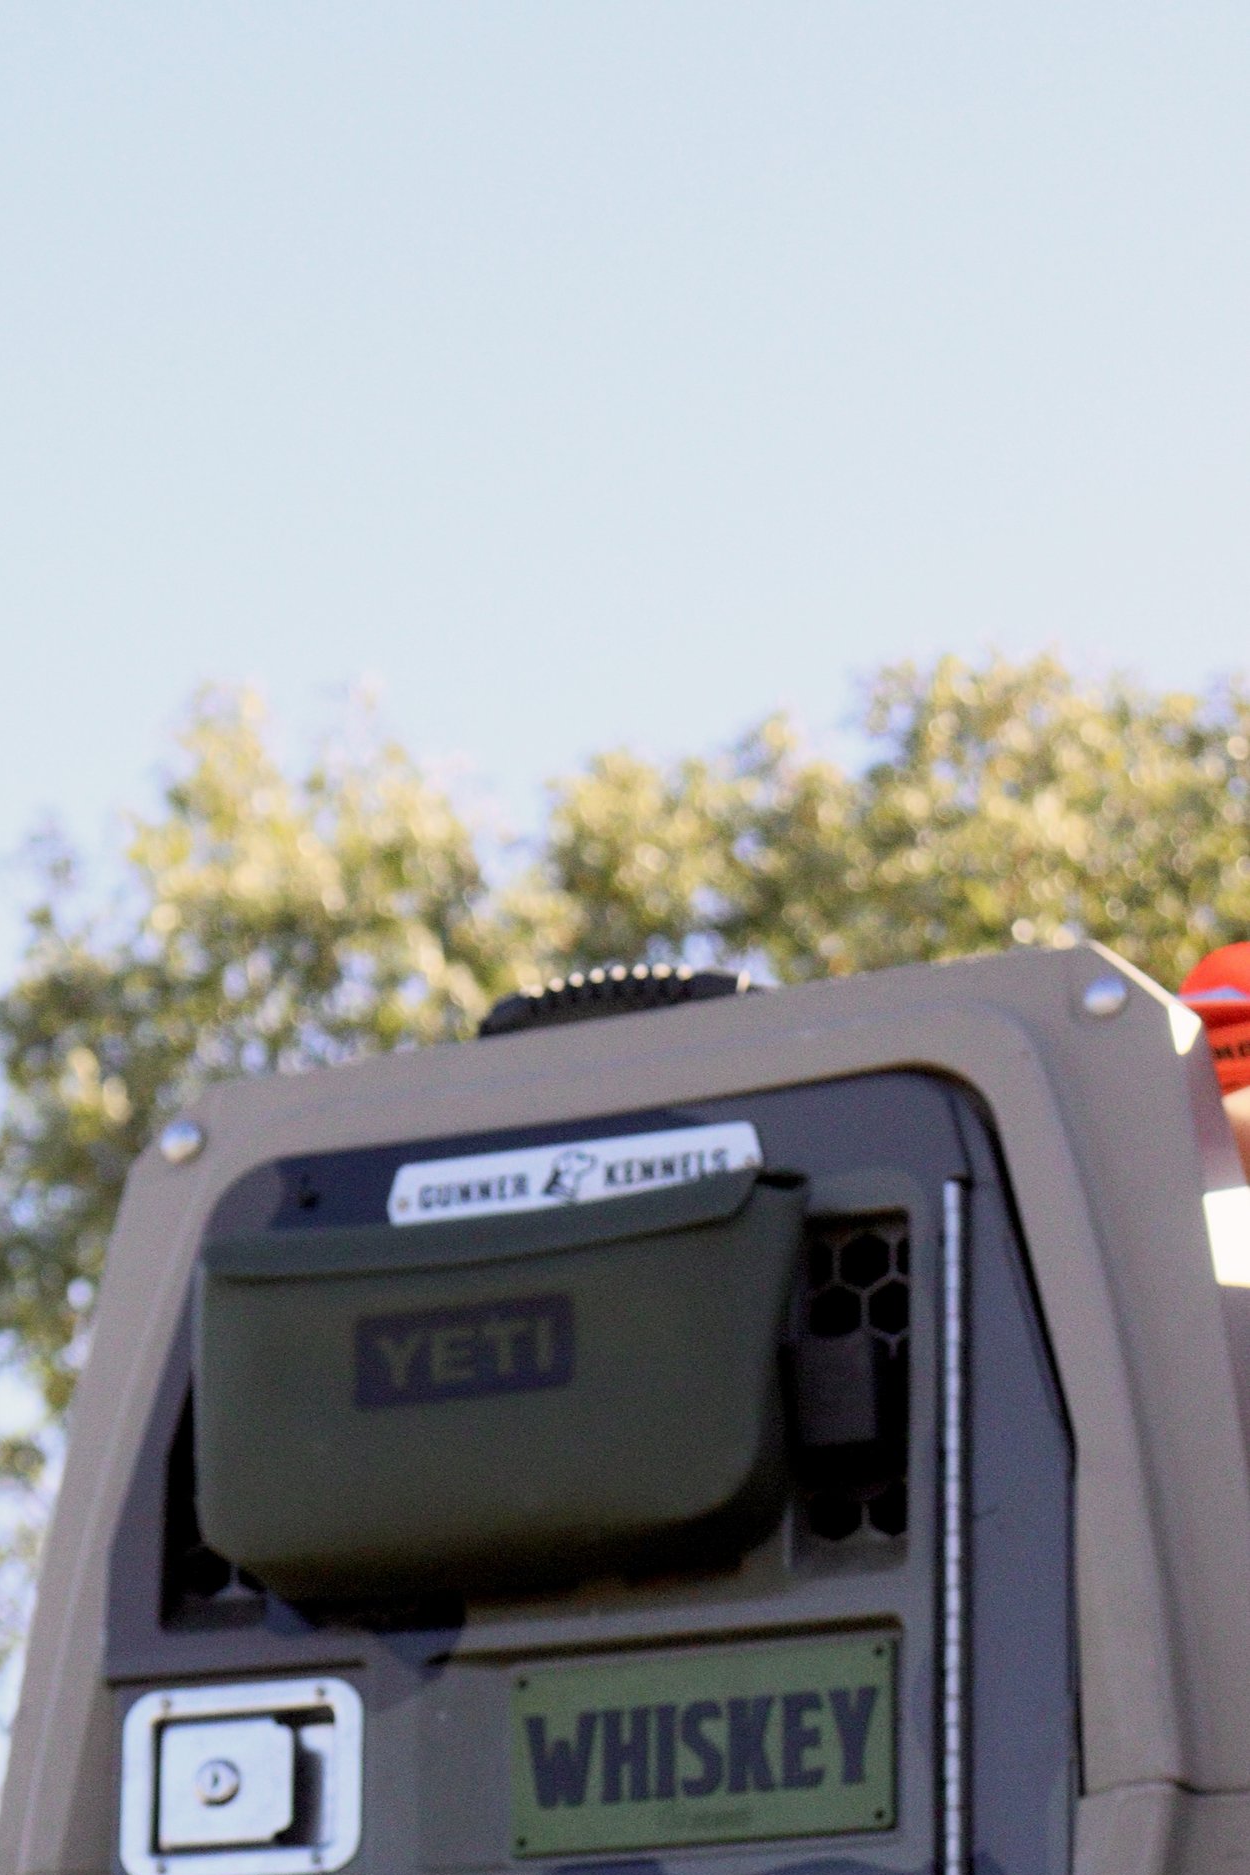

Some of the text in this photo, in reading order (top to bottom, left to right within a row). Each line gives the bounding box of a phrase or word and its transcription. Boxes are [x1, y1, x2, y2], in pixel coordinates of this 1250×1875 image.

[418, 1173, 530, 1211] GUNNER
[376, 1317, 552, 1389] YETI
[524, 1685, 878, 1810] WHISKEY
